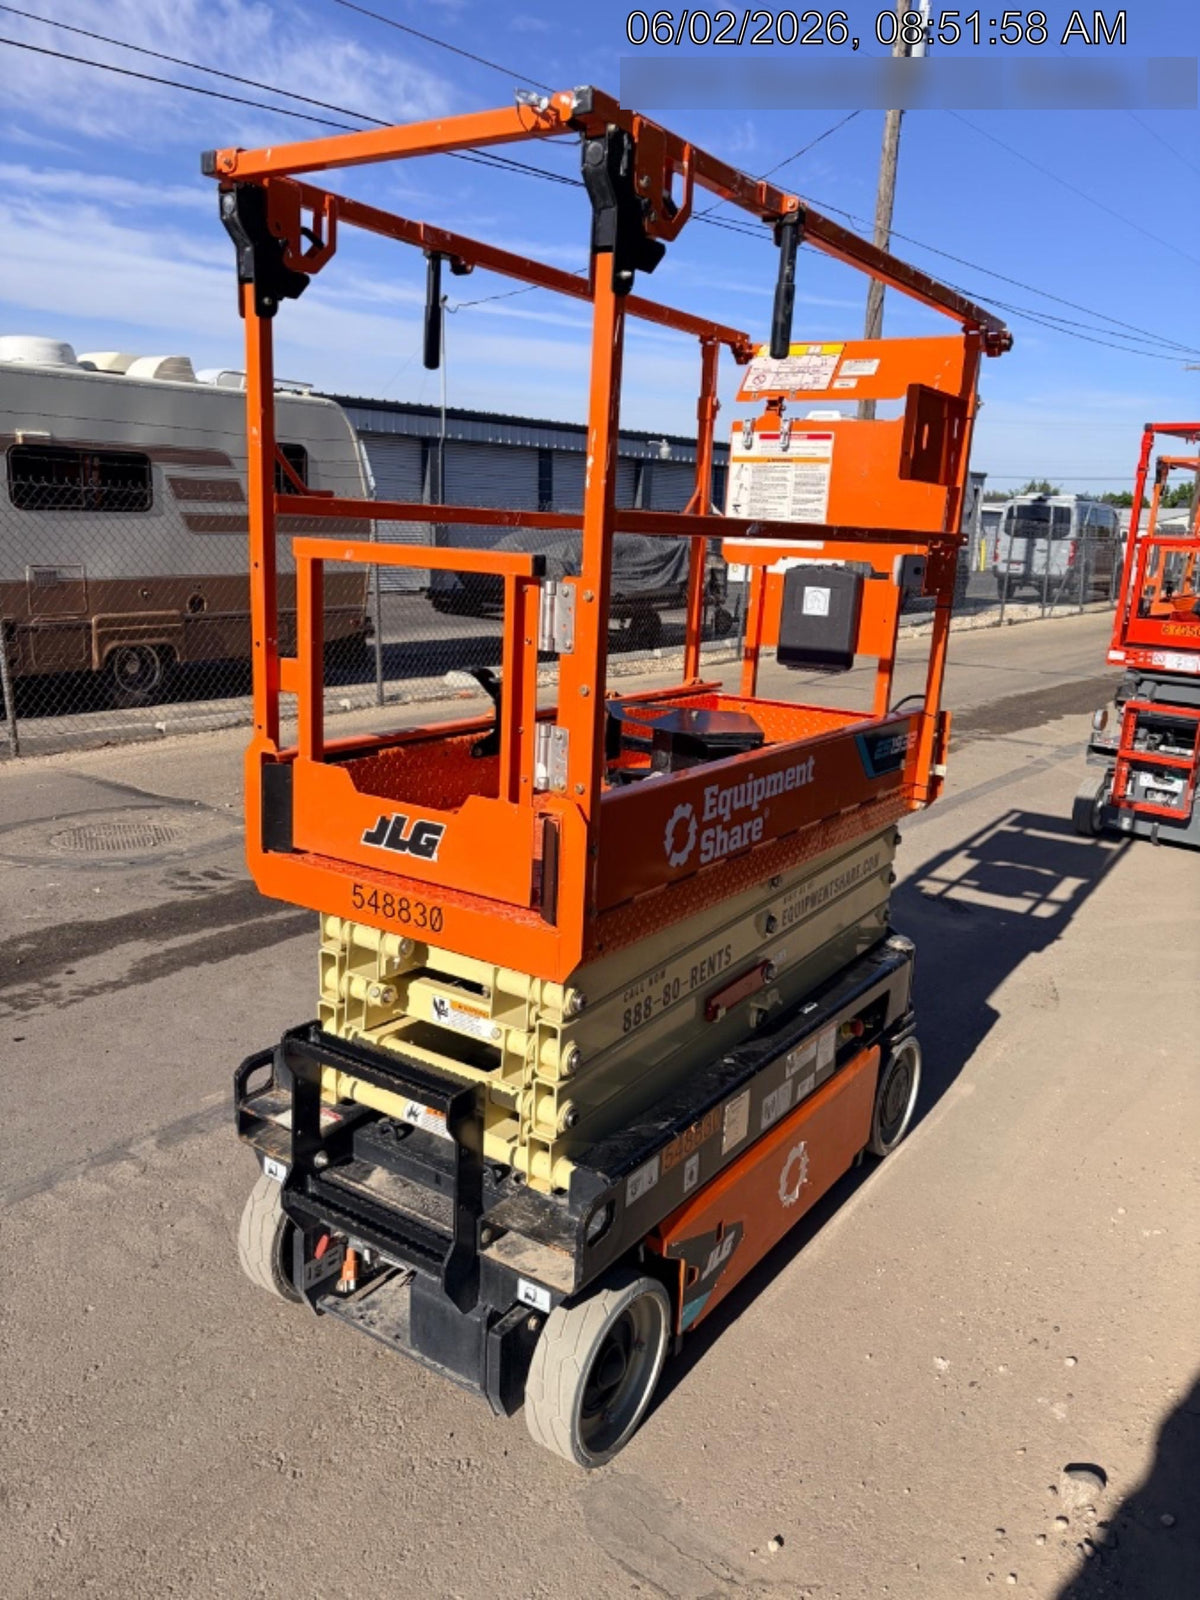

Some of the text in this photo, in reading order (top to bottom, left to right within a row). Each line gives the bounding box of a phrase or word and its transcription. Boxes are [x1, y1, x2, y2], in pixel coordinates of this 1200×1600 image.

[702, 755, 815, 823] Equipment
[361, 812, 447, 862] JLG
[352, 883, 443, 932] 548830
[622, 943, 732, 1033] 888-80-RENTS
[702, 1230, 737, 1282] JLG
